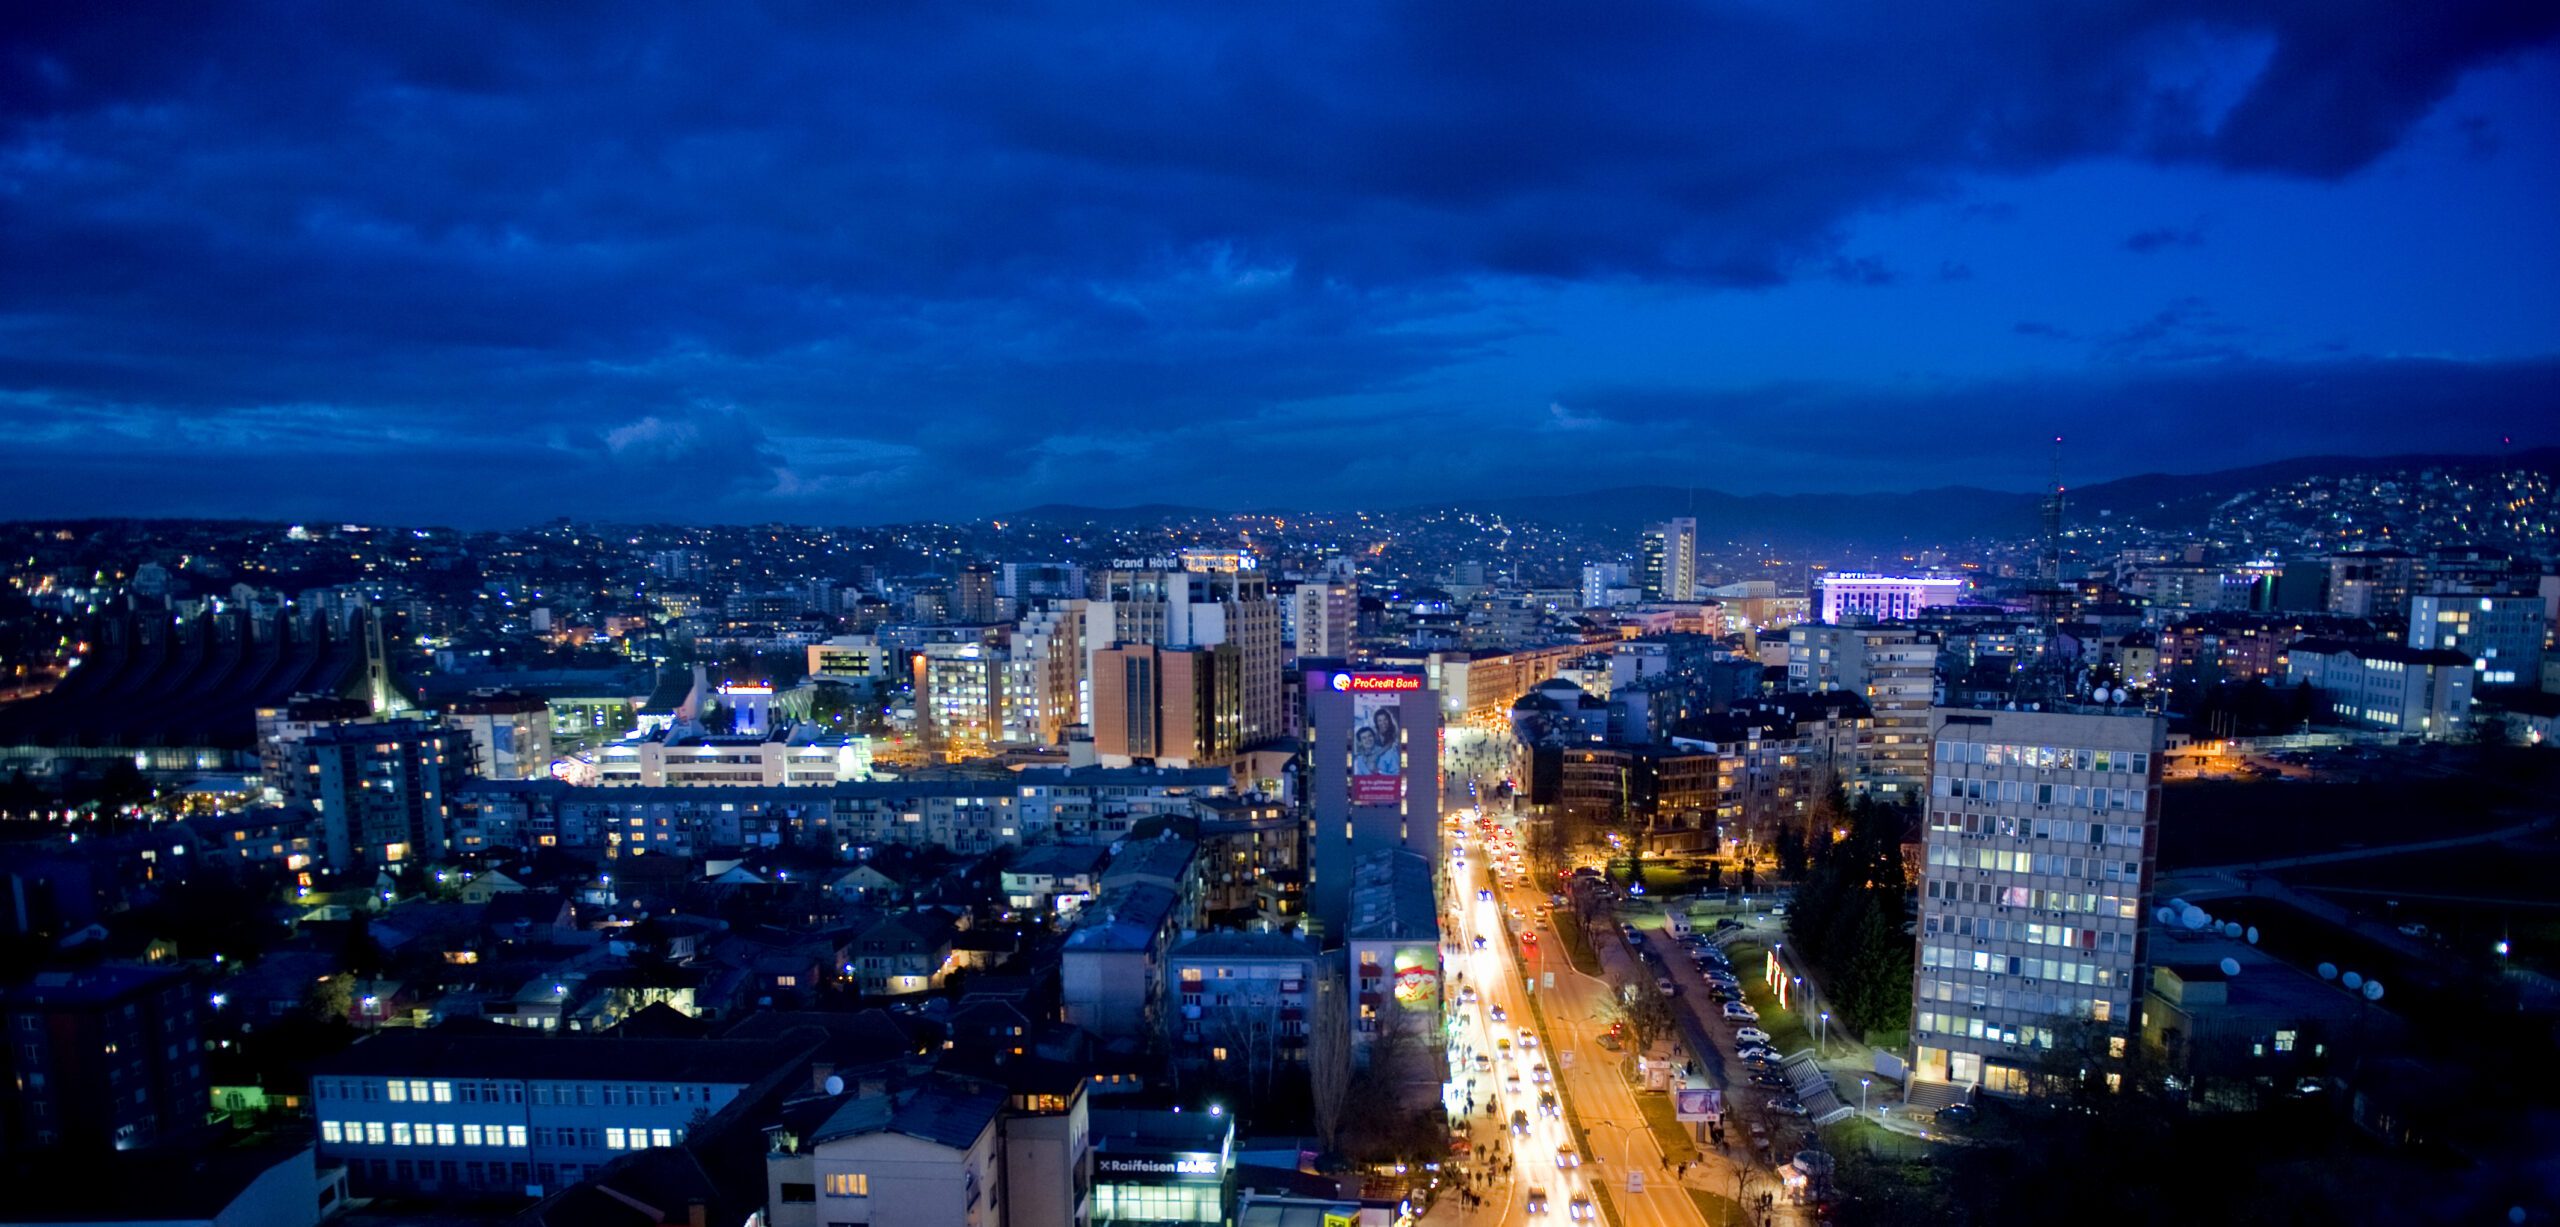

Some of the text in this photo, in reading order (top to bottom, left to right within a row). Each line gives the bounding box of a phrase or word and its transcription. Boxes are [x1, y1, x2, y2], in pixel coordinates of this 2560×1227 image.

[1113, 558, 1143, 568] Grand
[1149, 557, 1178, 568] Hotel
[1354, 677, 1419, 688] ProCredit Bank
[1112, 1160, 1216, 1173] Raiffeisen BANK
